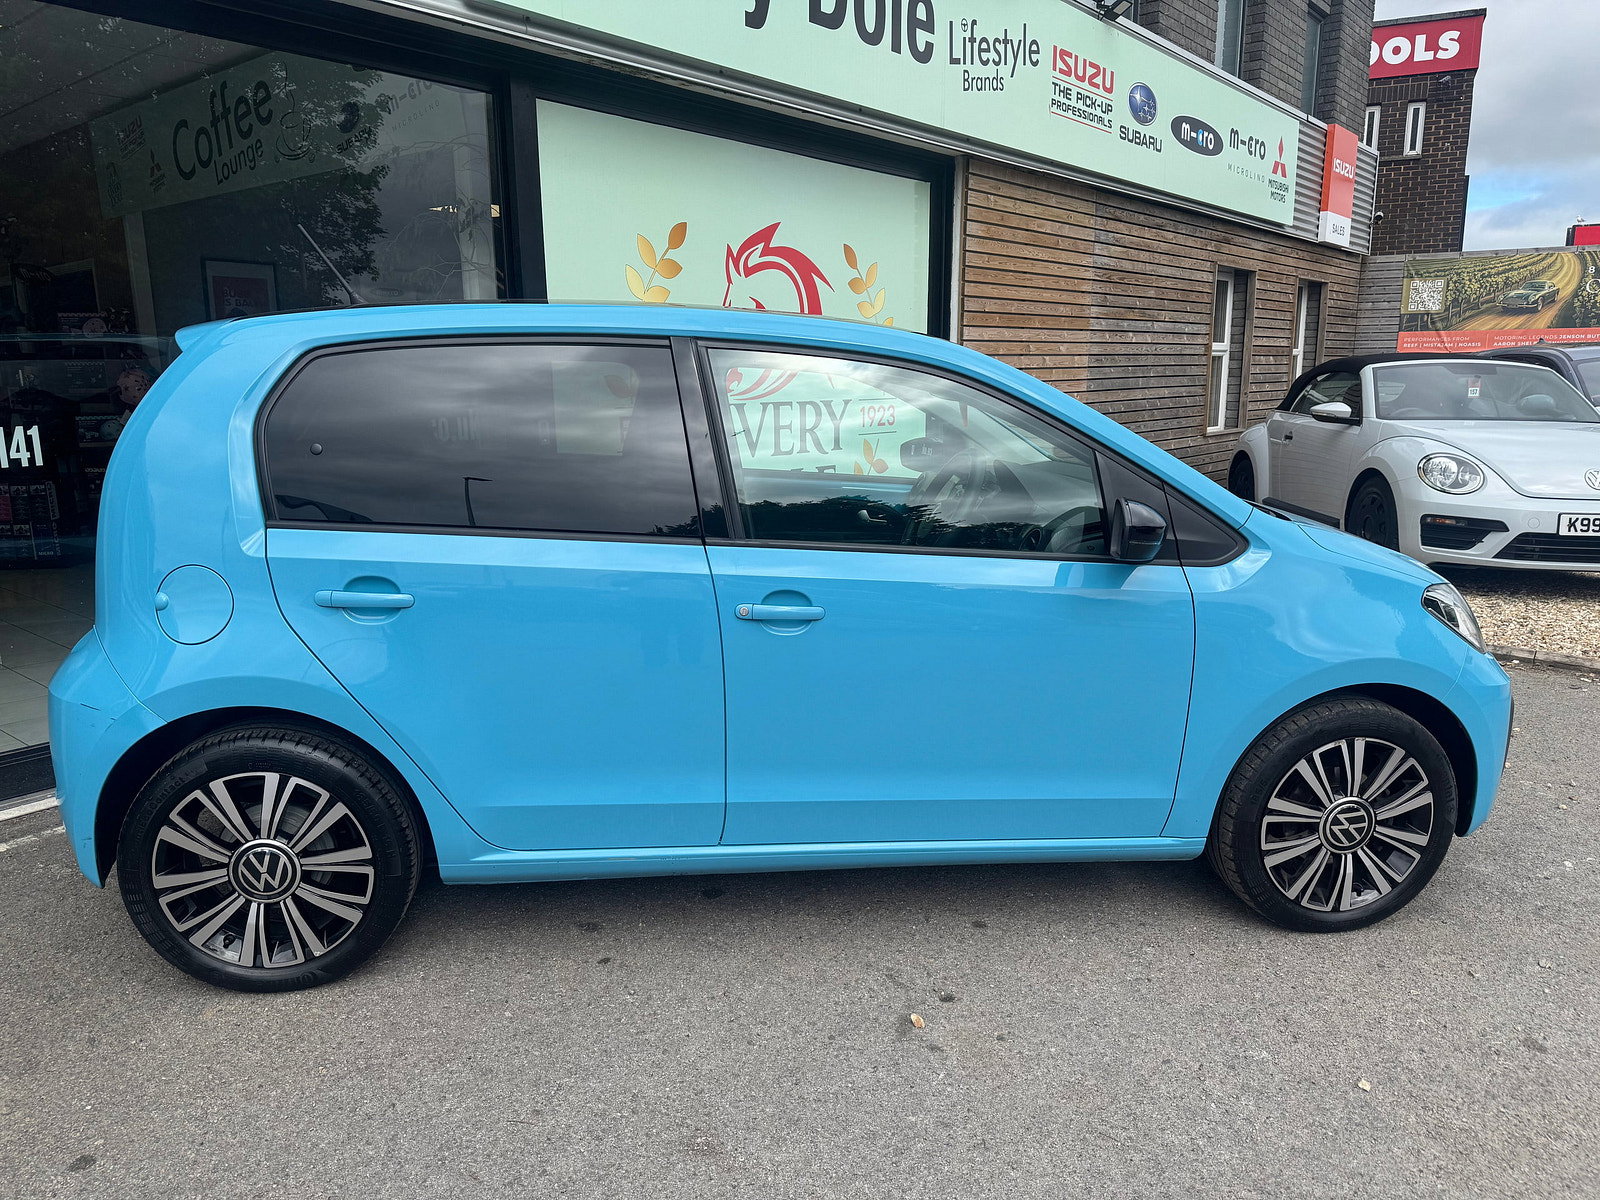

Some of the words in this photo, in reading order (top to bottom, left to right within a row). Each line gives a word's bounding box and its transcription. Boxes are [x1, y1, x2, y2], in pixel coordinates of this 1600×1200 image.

[949, 18, 1040, 78] Lifestyle
[963, 69, 1004, 92] Brands
[1052, 45, 1114, 94] ISUZU
[1052, 82, 1072, 101] THE
[1076, 91, 1113, 115] PICK-UP
[1051, 98, 1113, 129] PROFESSIONALS
[172, 80, 273, 180] Coffee
[1119, 125, 1162, 153] SUBARU
[214, 139, 263, 185] Lounge
[1227, 163, 1265, 183] MICROLINO
[1333, 157, 1355, 179] ISUZU
[1267, 178, 1289, 193] MITSUBISHI
[1270, 190, 1286, 204] MOTORS
[1332, 223, 1346, 237] SALES
[859, 404, 896, 428] 1923
[1567, 517, 1600, 533] K99
